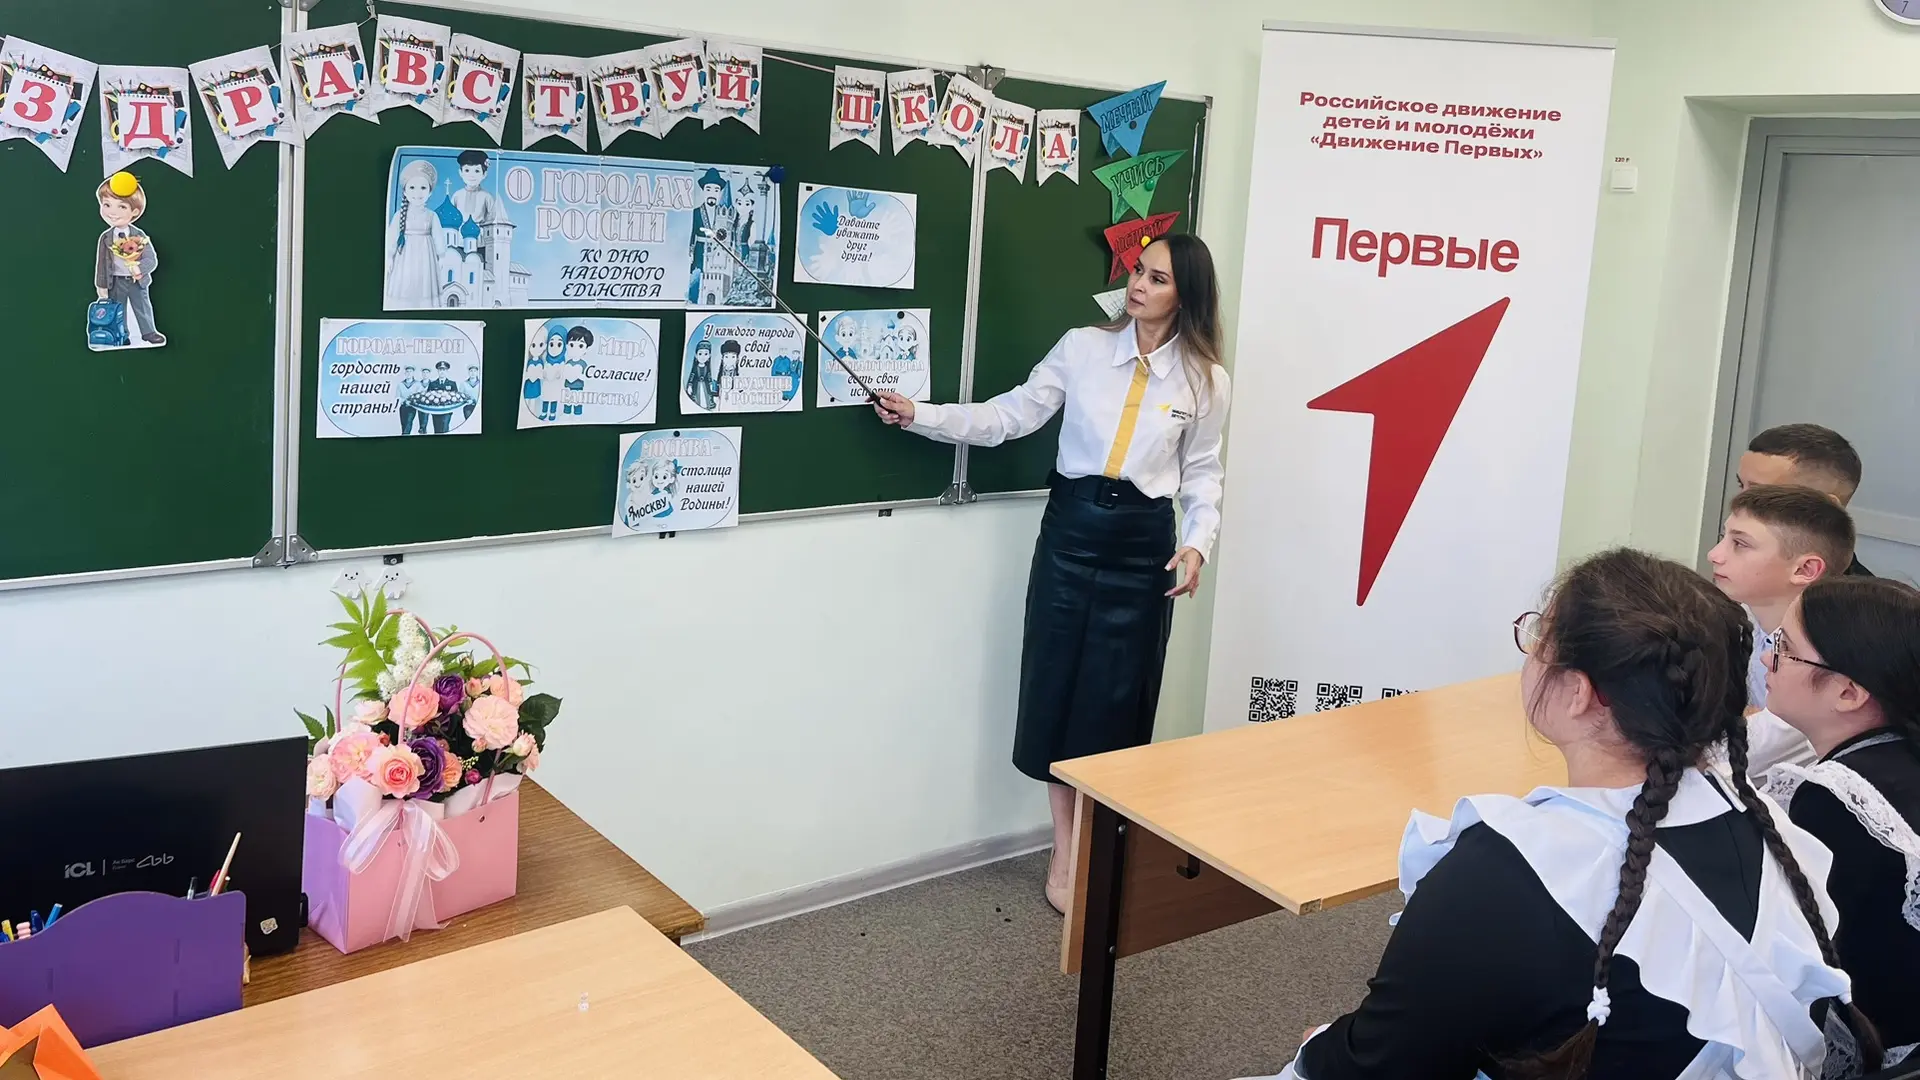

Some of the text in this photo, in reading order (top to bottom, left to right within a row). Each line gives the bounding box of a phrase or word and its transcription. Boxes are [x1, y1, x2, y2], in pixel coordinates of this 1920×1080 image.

[1902, 0, 1909, 13] 7
[1100, 90, 1153, 133] МЕЧТАЙ
[1299, 91, 1561, 122] Российское движение
[1322, 115, 1534, 140] детей и молодёжи
[1310, 132, 1543, 160] «Движение Первых»
[1110, 156, 1165, 197] УЧИСЬ
[506, 167, 694, 210] О ГОРОДАХ
[536, 207, 667, 243] РОССИИ
[838, 215, 881, 230] Давайте
[836, 228, 880, 240] уважать
[846, 240, 867, 252] друг
[1311, 216, 1520, 278] Первые
[607, 249, 649, 264] ДНЮ
[841, 251, 872, 263] друга!
[704, 324, 795, 339] У каждого народа
[597, 335, 647, 360] Мир!
[744, 340, 770, 352] свой
[331, 360, 401, 377] гордость
[739, 356, 773, 368] вклад
[585, 365, 651, 381] Согласие!
[876, 372, 900, 384] своя
[340, 381, 391, 394] нашей
[331, 398, 399, 417] страны!
[681, 466, 732, 478] столица
[685, 482, 725, 494] нашей
[632, 496, 667, 521] МОСКВУ
[680, 497, 731, 511] Родины!
